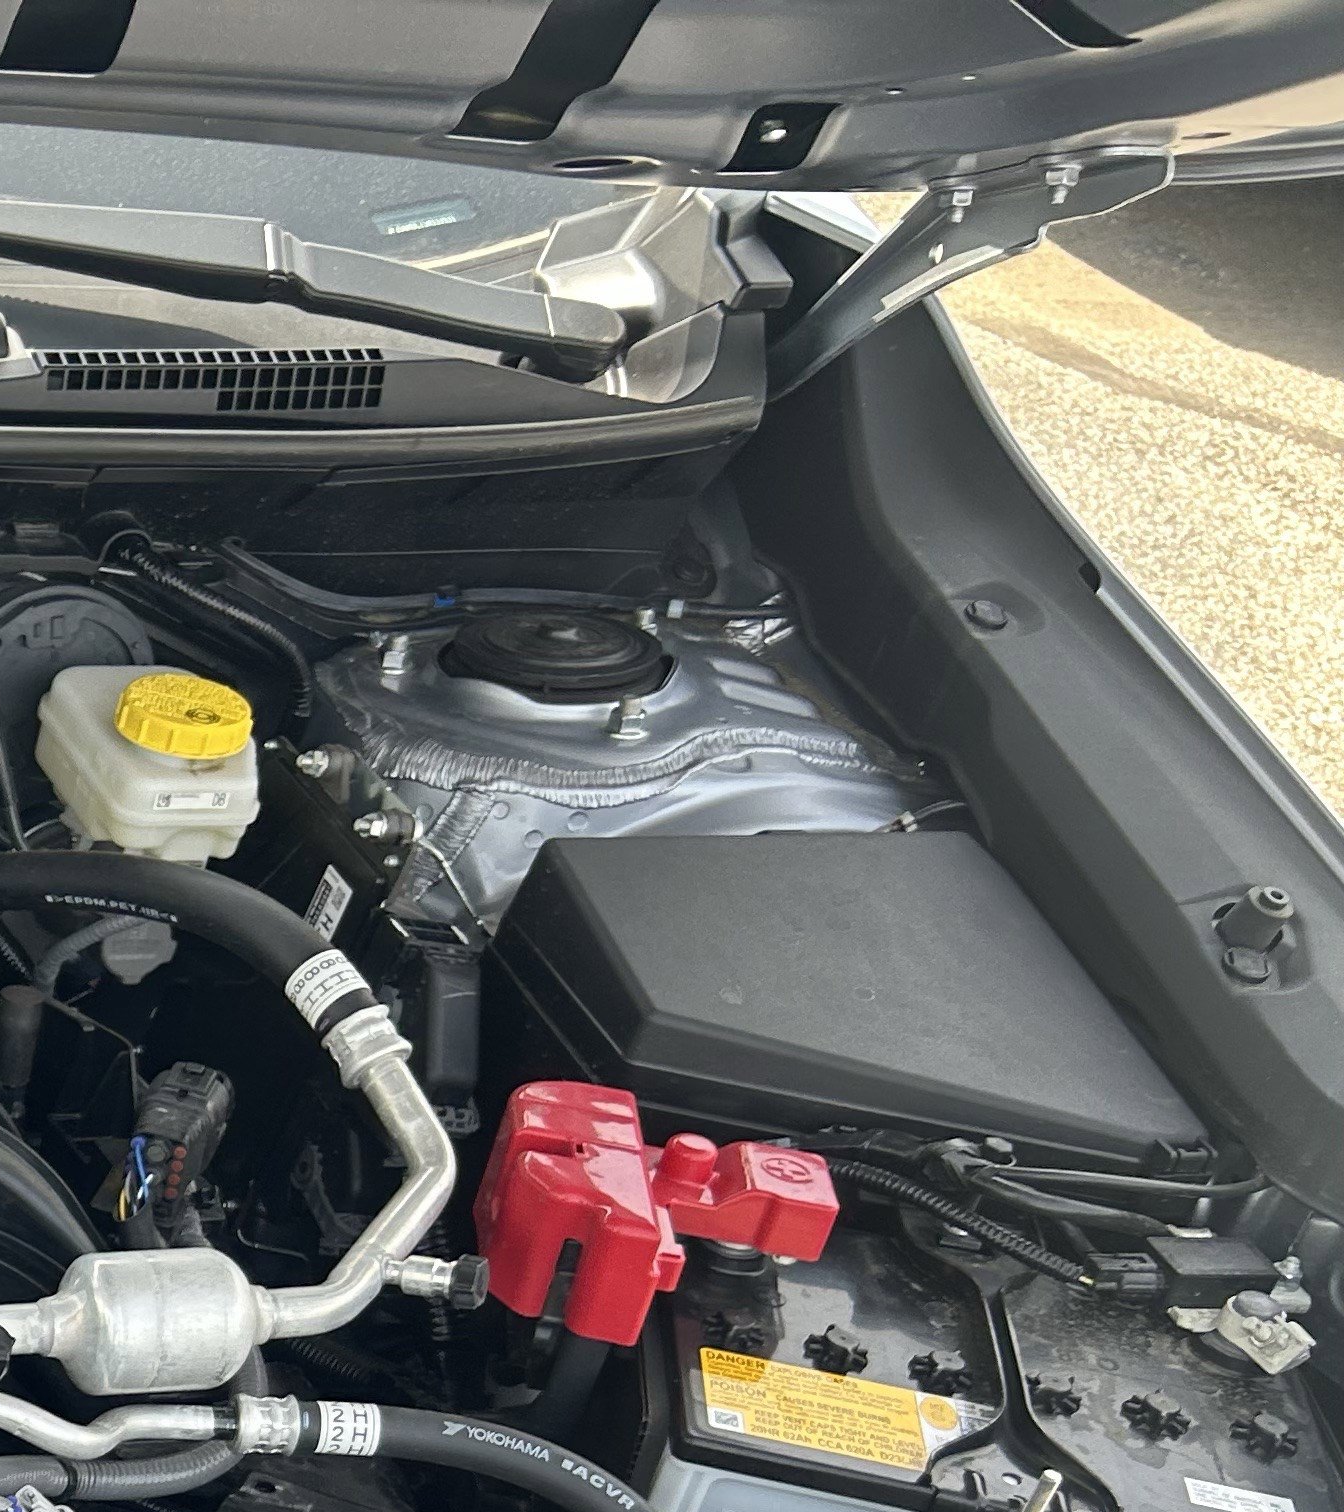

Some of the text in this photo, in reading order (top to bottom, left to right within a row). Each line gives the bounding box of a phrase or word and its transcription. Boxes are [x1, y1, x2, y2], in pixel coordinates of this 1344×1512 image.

[706, 1351, 765, 1370] DANGER
[710, 1379, 767, 1399] POISON
[775, 1393, 815, 1409] CAUSES
[817, 1401, 854, 1417] SEVERE
[857, 1410, 891, 1425] BURNS
[332, 1408, 368, 1424] 2 H
[754, 1408, 779, 1420] KEEP
[783, 1414, 808, 1426] VENT
[810, 1420, 837, 1432] CAPS
[331, 1426, 368, 1443] 2 H
[817, 1437, 844, 1451] CCA
[465, 1426, 551, 1462] YOKOHAMA
[572, 1466, 635, 1511] ACVR
